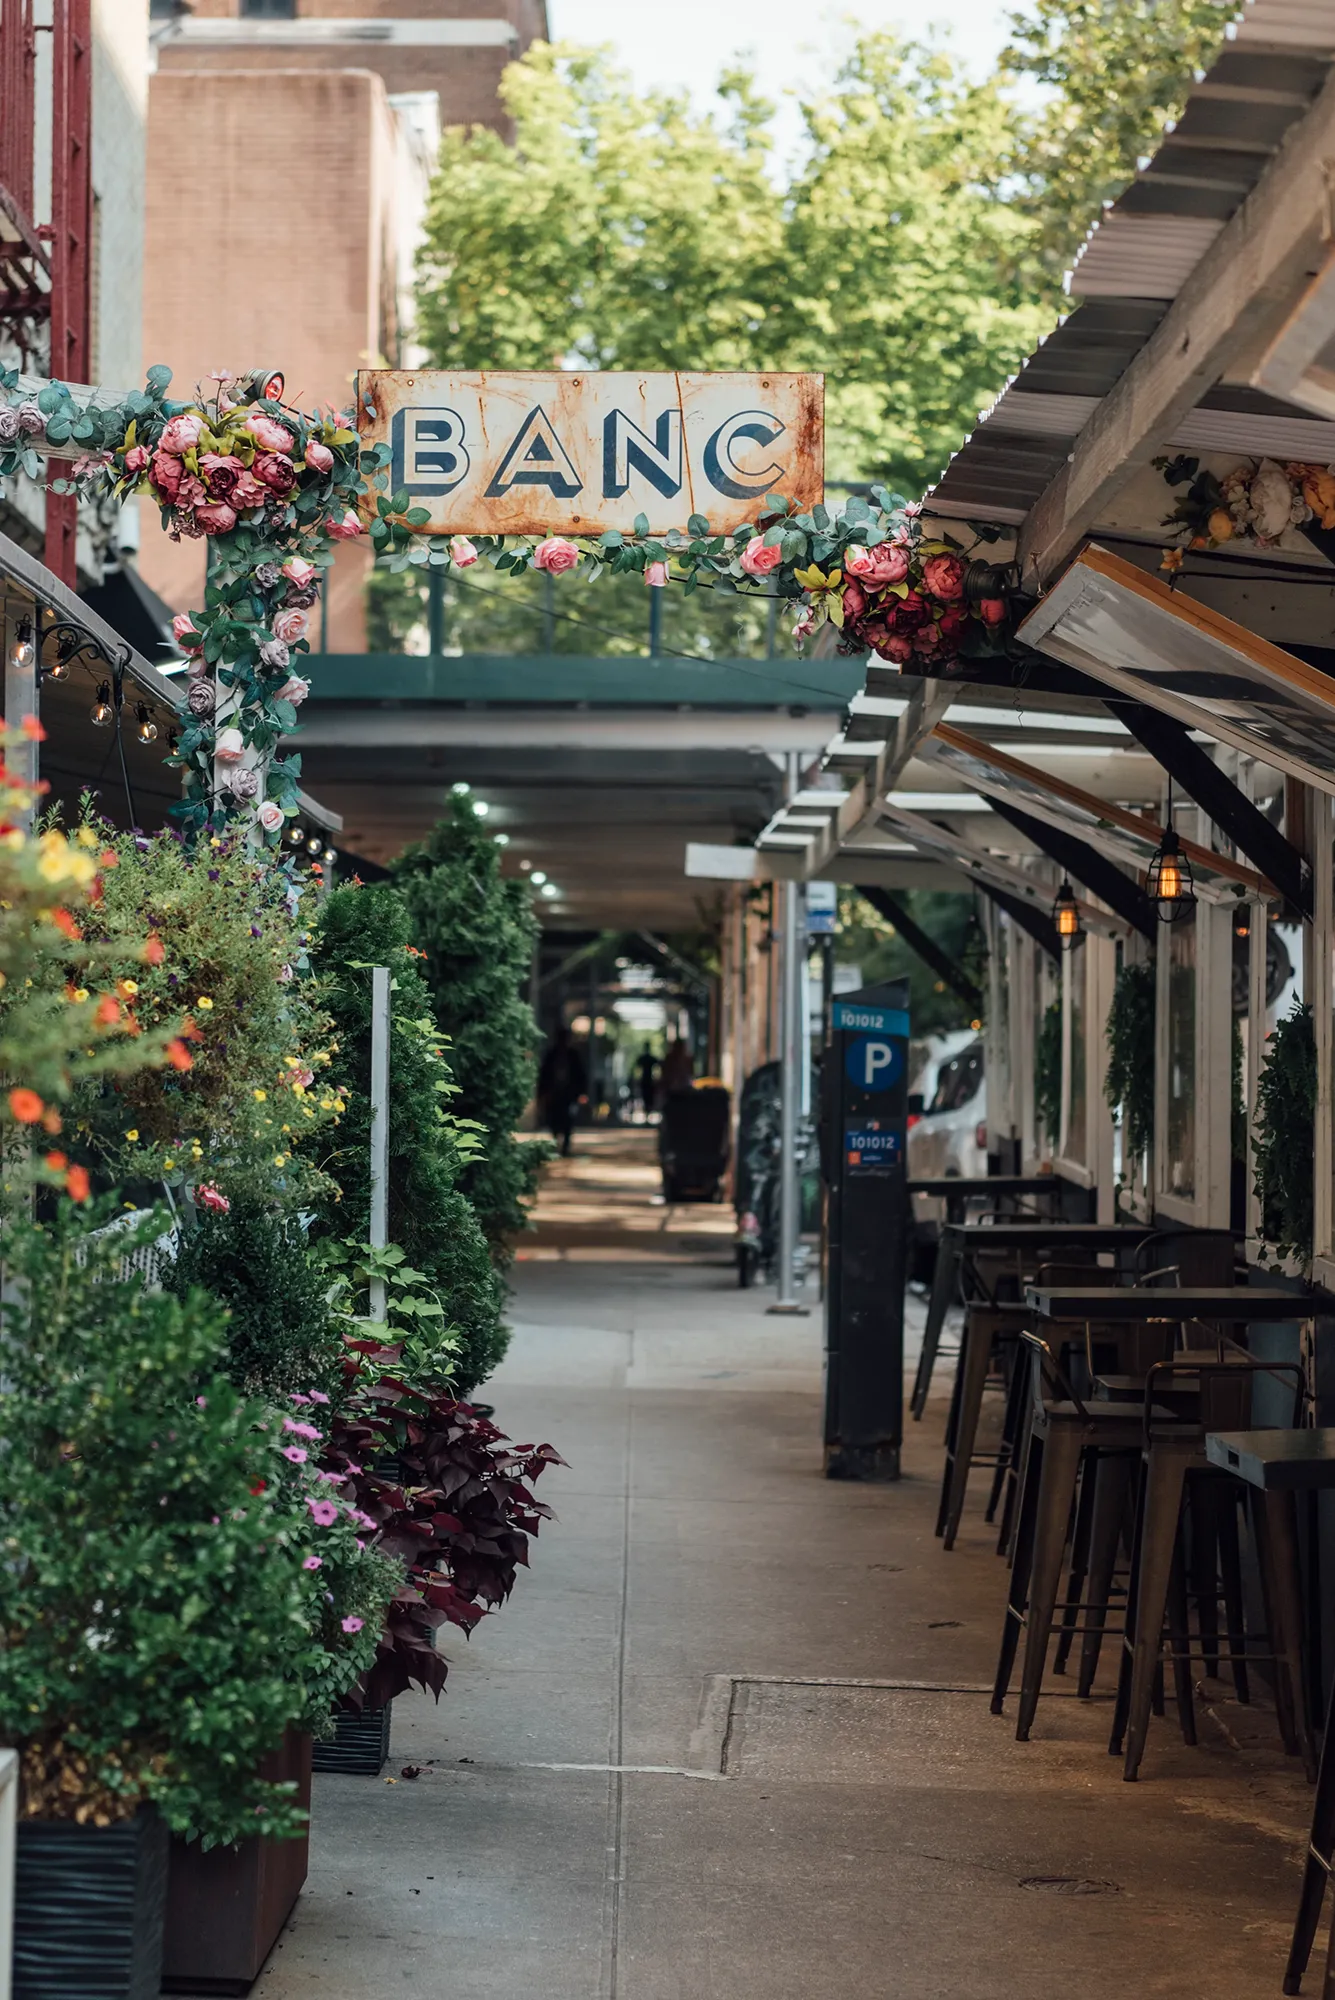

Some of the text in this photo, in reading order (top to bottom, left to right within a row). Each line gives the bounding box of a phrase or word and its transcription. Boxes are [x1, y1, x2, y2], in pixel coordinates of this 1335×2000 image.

[391, 404, 787, 500] BANC
[841, 1013, 884, 1029] 101012
[864, 1042, 893, 1084] P
[851, 1136, 895, 1149] 101012
